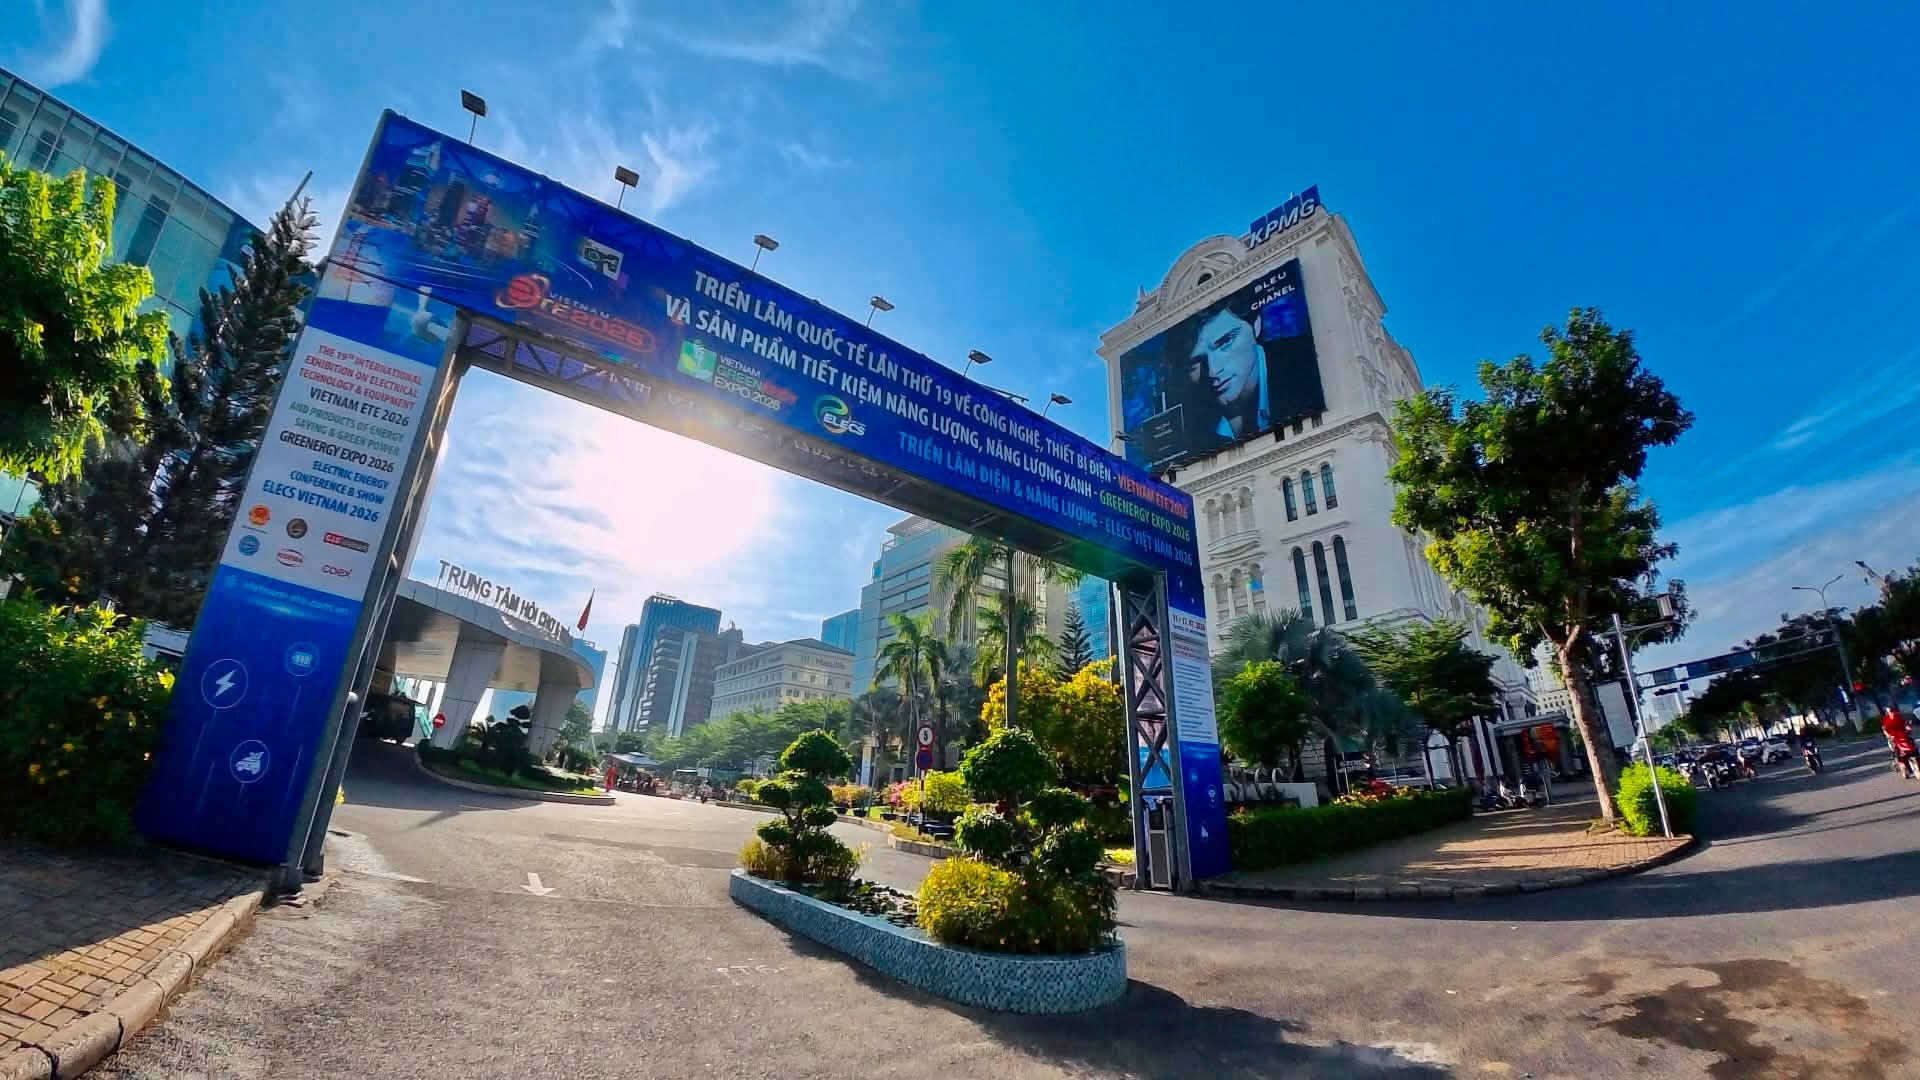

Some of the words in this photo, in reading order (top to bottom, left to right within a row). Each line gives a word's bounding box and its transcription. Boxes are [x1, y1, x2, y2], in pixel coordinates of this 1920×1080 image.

[1249, 198, 1314, 248] KPMG
[1251, 284, 1295, 309] CHANEL
[1254, 271, 1286, 292] BLEU
[304, 355, 353, 377] EXHIBITION
[354, 371, 369, 383] ON
[370, 375, 416, 396] ELECTRICAL
[319, 344, 336, 357] THE
[354, 358, 421, 384] INTERNATIONAL
[695, 270, 750, 312] TRIỂN
[754, 299, 792, 333] LÃM
[797, 319, 842, 355] QUỐC
[847, 341, 867, 365] TẾ
[869, 353, 898, 381] LẦN
[902, 367, 932, 395] THỨ
[935, 384, 951, 404] 19
[954, 393, 971, 415] VỀ
[973, 403, 1006, 432] CÔNG
[1009, 421, 1043, 452] NGHỆ,
[1046, 437, 1074, 464] THIẾT
[1077, 453, 1088, 475] BỊ
[719, 355, 760, 376] VIETNAM
[299, 367, 353, 391] TECHNOLOGY
[355, 386, 363, 395] &
[363, 388, 416, 409] EQUIPMENT
[310, 386, 359, 410] VIETNAM
[360, 402, 381, 417] ETE
[381, 409, 409, 426] 2026
[714, 376, 750, 398] EXPO
[751, 391, 781, 411] 2026
[289, 401, 310, 414] AND
[309, 407, 355, 428] PRODUCTS
[356, 421, 369, 432] OF
[369, 424, 404, 442] ENERGY
[294, 417, 327, 435] SAVING
[328, 429, 337, 438] &
[337, 431, 365, 446] GREEN
[367, 439, 400, 456] POWER
[665, 293, 690, 324] VÀ
[696, 309, 736, 344] SẢN
[740, 328, 796, 369] PHẨM
[802, 353, 837, 386] TIẾT
[841, 371, 881, 406] KIỆM
[885, 391, 928, 426] NĂNG
[932, 412, 982, 453] LƯỢNG,
[986, 437, 1020, 467] NĂNG
[1023, 453, 1061, 485] LƯỢNG
[1063, 472, 1091, 497] XANH
[1100, 489, 1149, 523] GREENERGY
[1151, 512, 1170, 532] EXPO
[1172, 522, 1189, 541] 2026
[823, 412, 865, 436] ELECS
[279, 430, 340, 456] GREENERGY
[340, 447, 367, 464] EXPO
[368, 456, 394, 472] 2026
[290, 470, 347, 495] CONFERENCE
[347, 487, 356, 497] &
[356, 489, 384, 504] SHOW
[312, 460, 353, 480] ELECTRIC
[354, 471, 389, 489] ENERGY
[262, 479, 295, 498] ELECS
[297, 488, 348, 514] VIETNAM
[349, 504, 380, 522] 2026
[898, 431, 942, 464] TRIỂN
[946, 449, 975, 479] LÃM
[1014, 480, 1023, 497] &
[1062, 499, 1096, 527] LƯỢNG
[1106, 518, 1131, 540] ELECS
[1133, 529, 1151, 551] VIỆT
[1154, 538, 1172, 557] NAM
[1174, 546, 1192, 565] 2026
[439, 559, 491, 598] TRUNG
[494, 586, 520, 613] TÂM
[923, 731, 928, 741] 5
